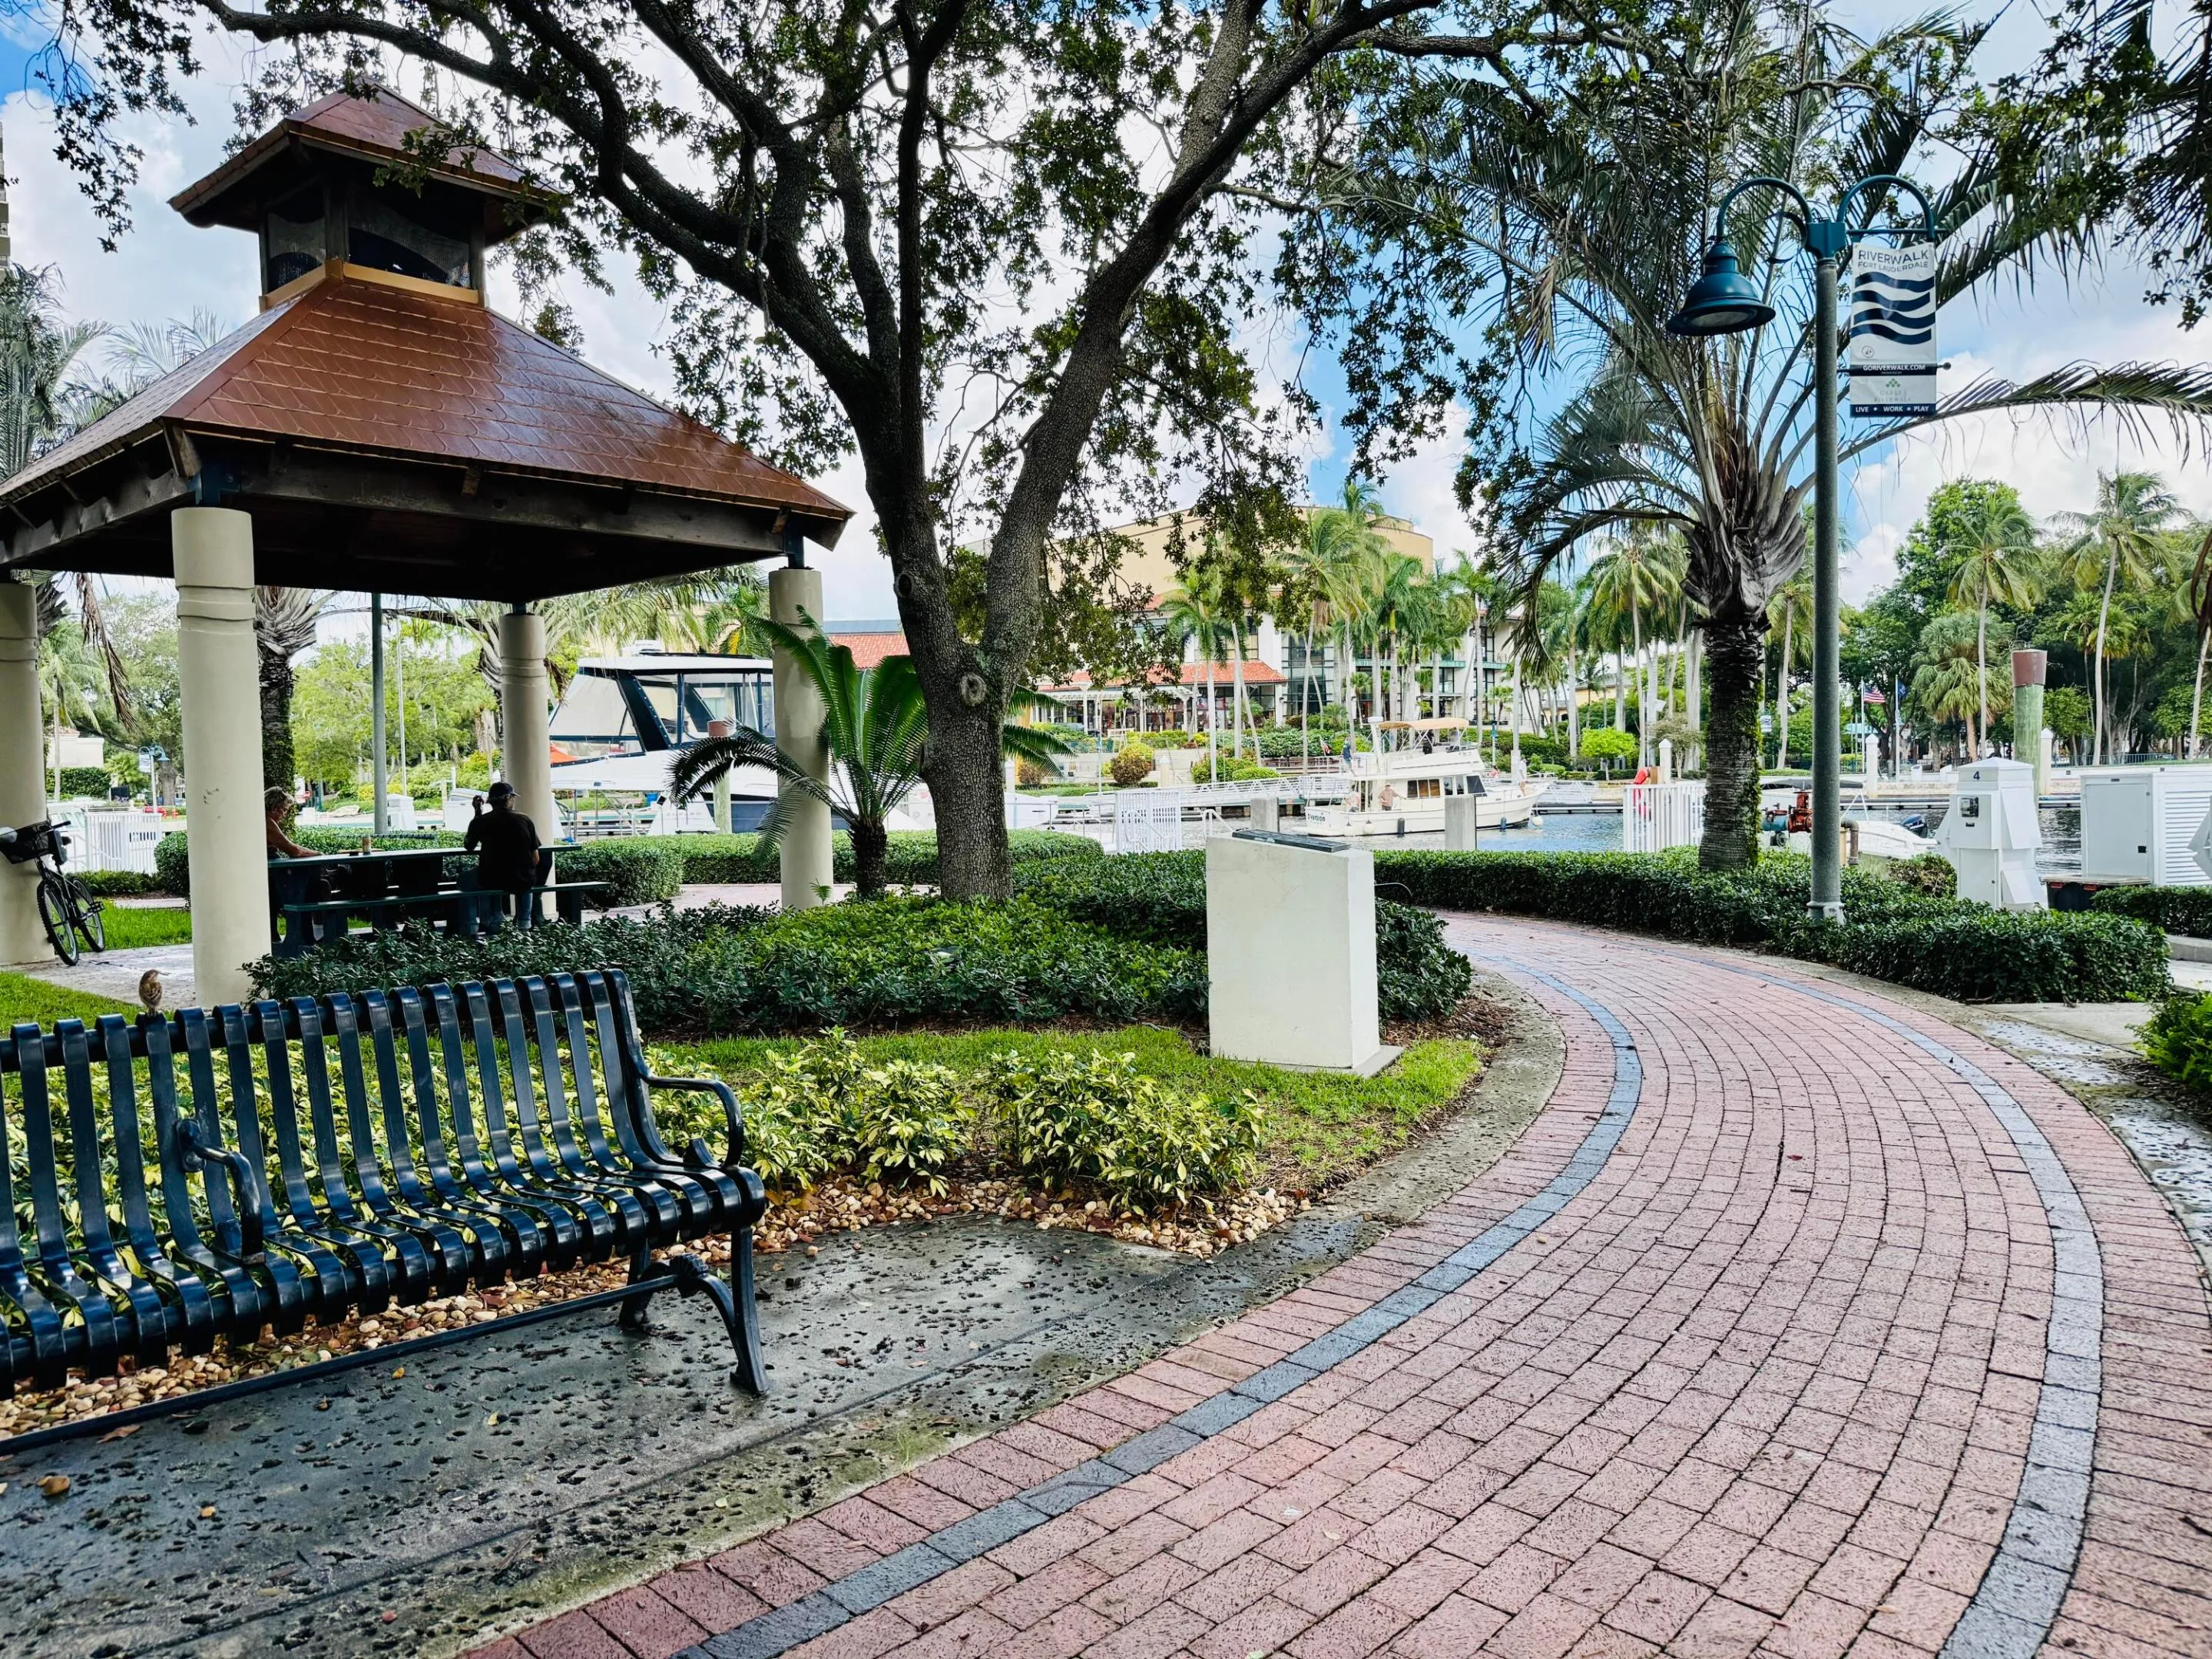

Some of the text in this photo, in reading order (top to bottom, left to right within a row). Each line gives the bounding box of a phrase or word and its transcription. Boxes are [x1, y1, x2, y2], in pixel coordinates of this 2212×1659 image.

[1859, 250, 1929, 264] RIVERWALK
[1879, 261, 1929, 272] LAUDERDALE
[1973, 771, 1980, 780] 4
